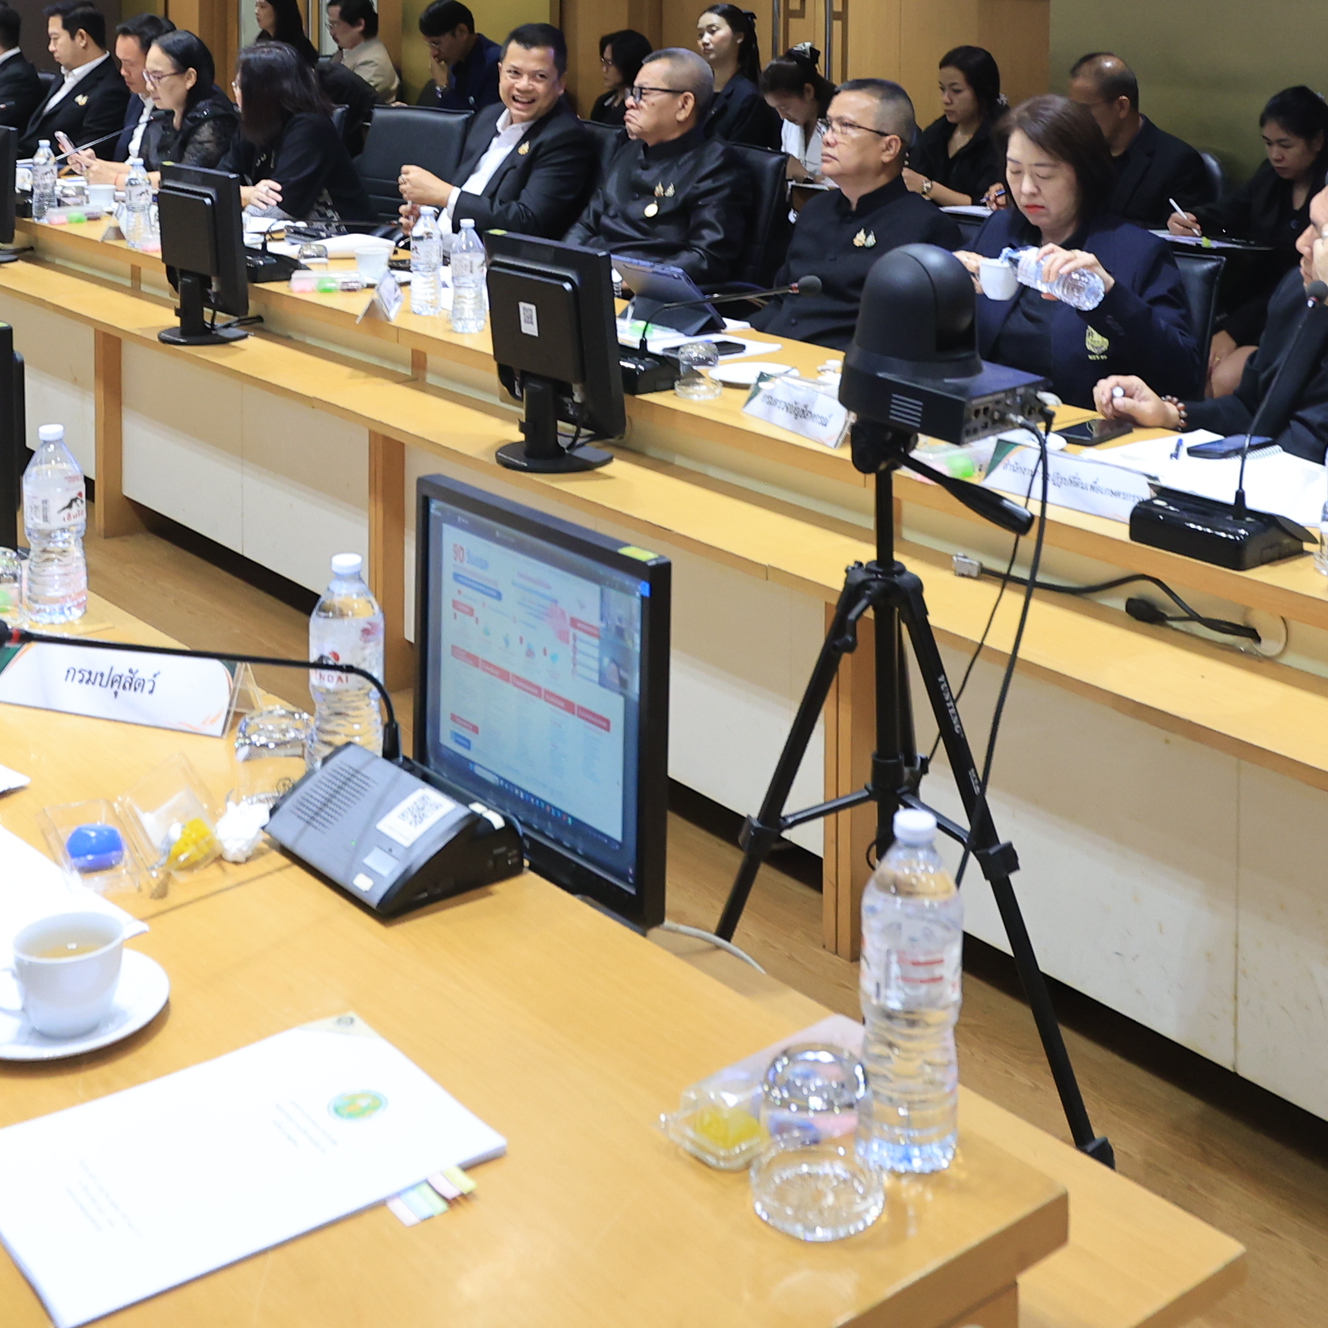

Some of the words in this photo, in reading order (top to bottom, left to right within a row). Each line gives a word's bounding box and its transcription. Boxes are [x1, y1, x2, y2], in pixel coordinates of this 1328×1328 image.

[64, 666, 161, 699] กรมปศุสัตว์
